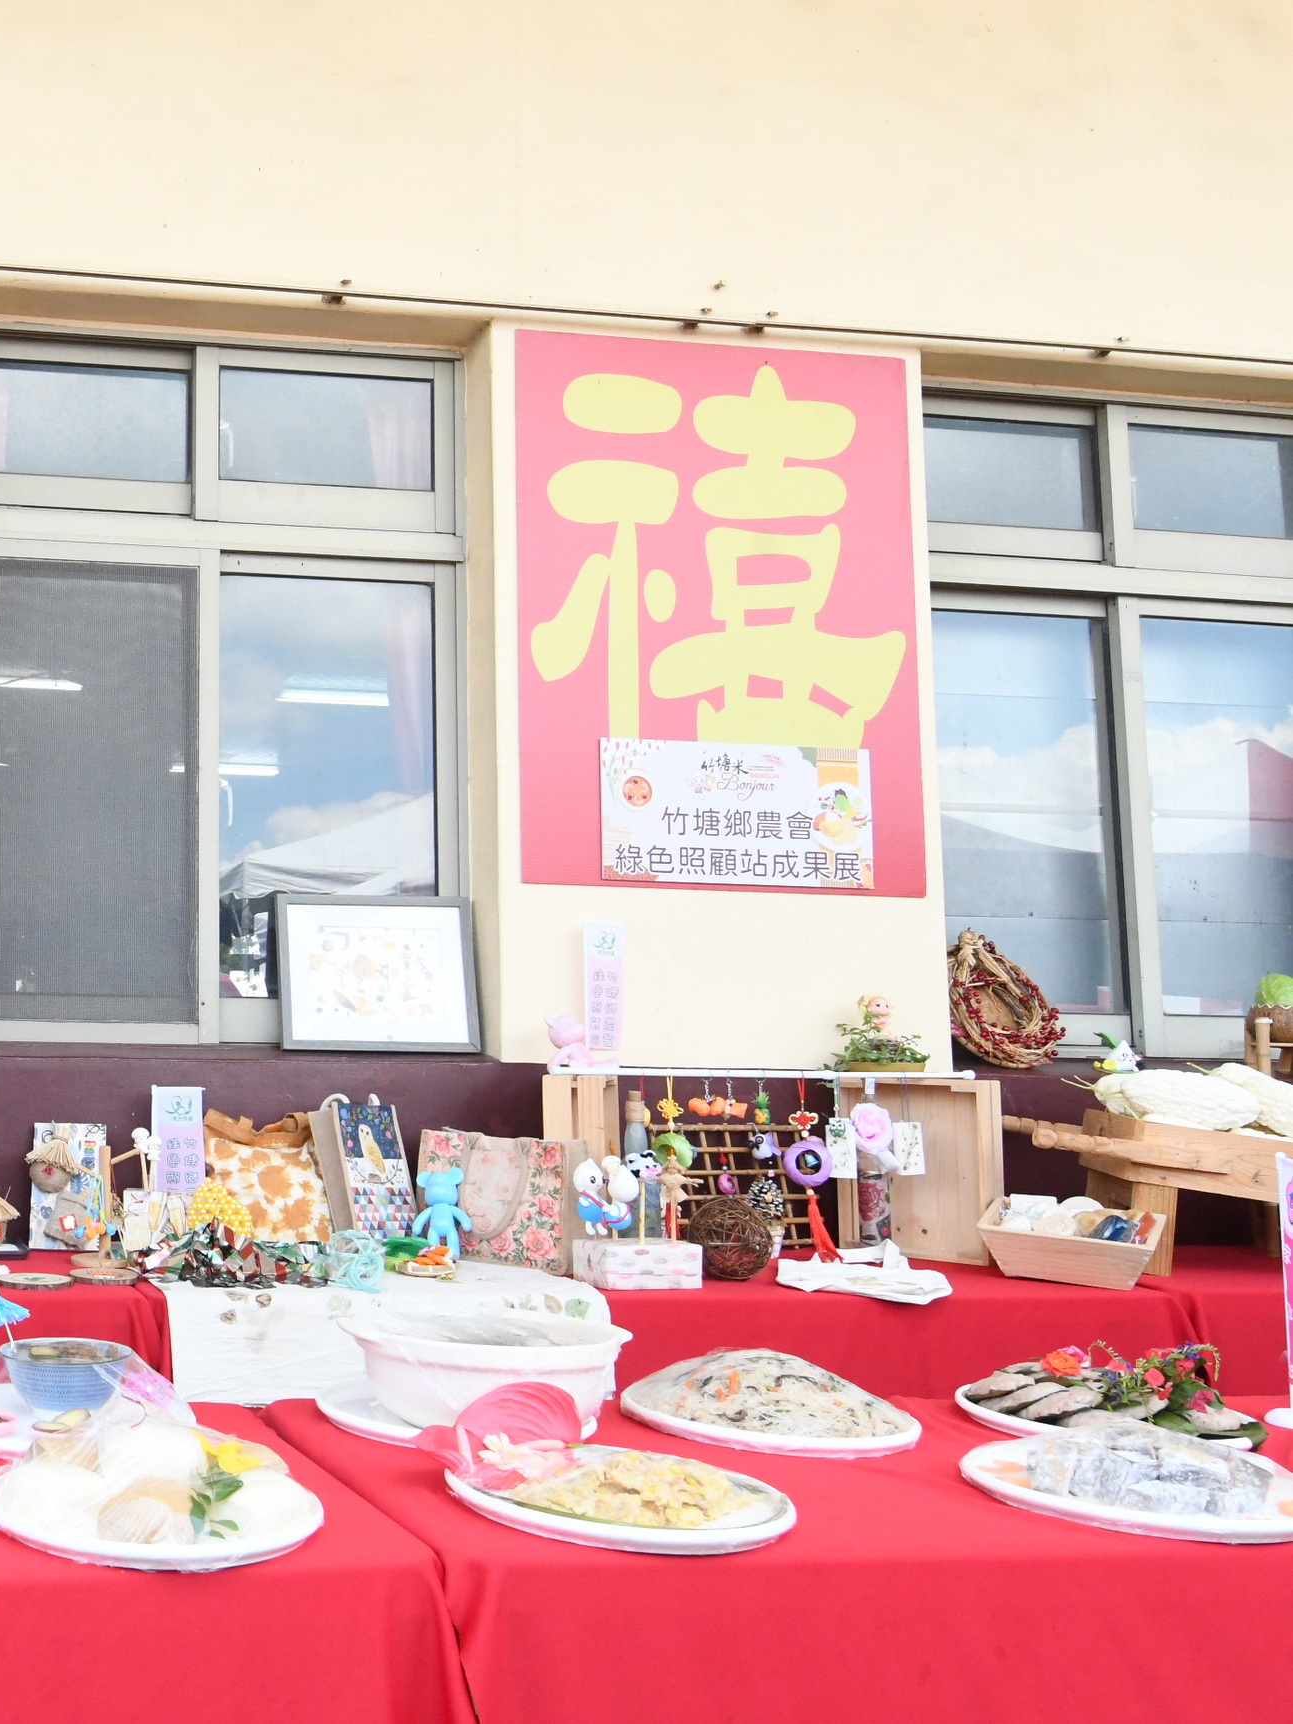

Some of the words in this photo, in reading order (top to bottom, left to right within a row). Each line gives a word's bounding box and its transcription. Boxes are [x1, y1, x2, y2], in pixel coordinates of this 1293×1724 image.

[531, 365, 906, 746] 禧
[701, 752, 749, 775] 竹塘米
[717, 772, 775, 801] Bonjour
[661, 806, 814, 840] 竹塘鄉農會
[615, 843, 861, 882] 綠色照顧站成果展
